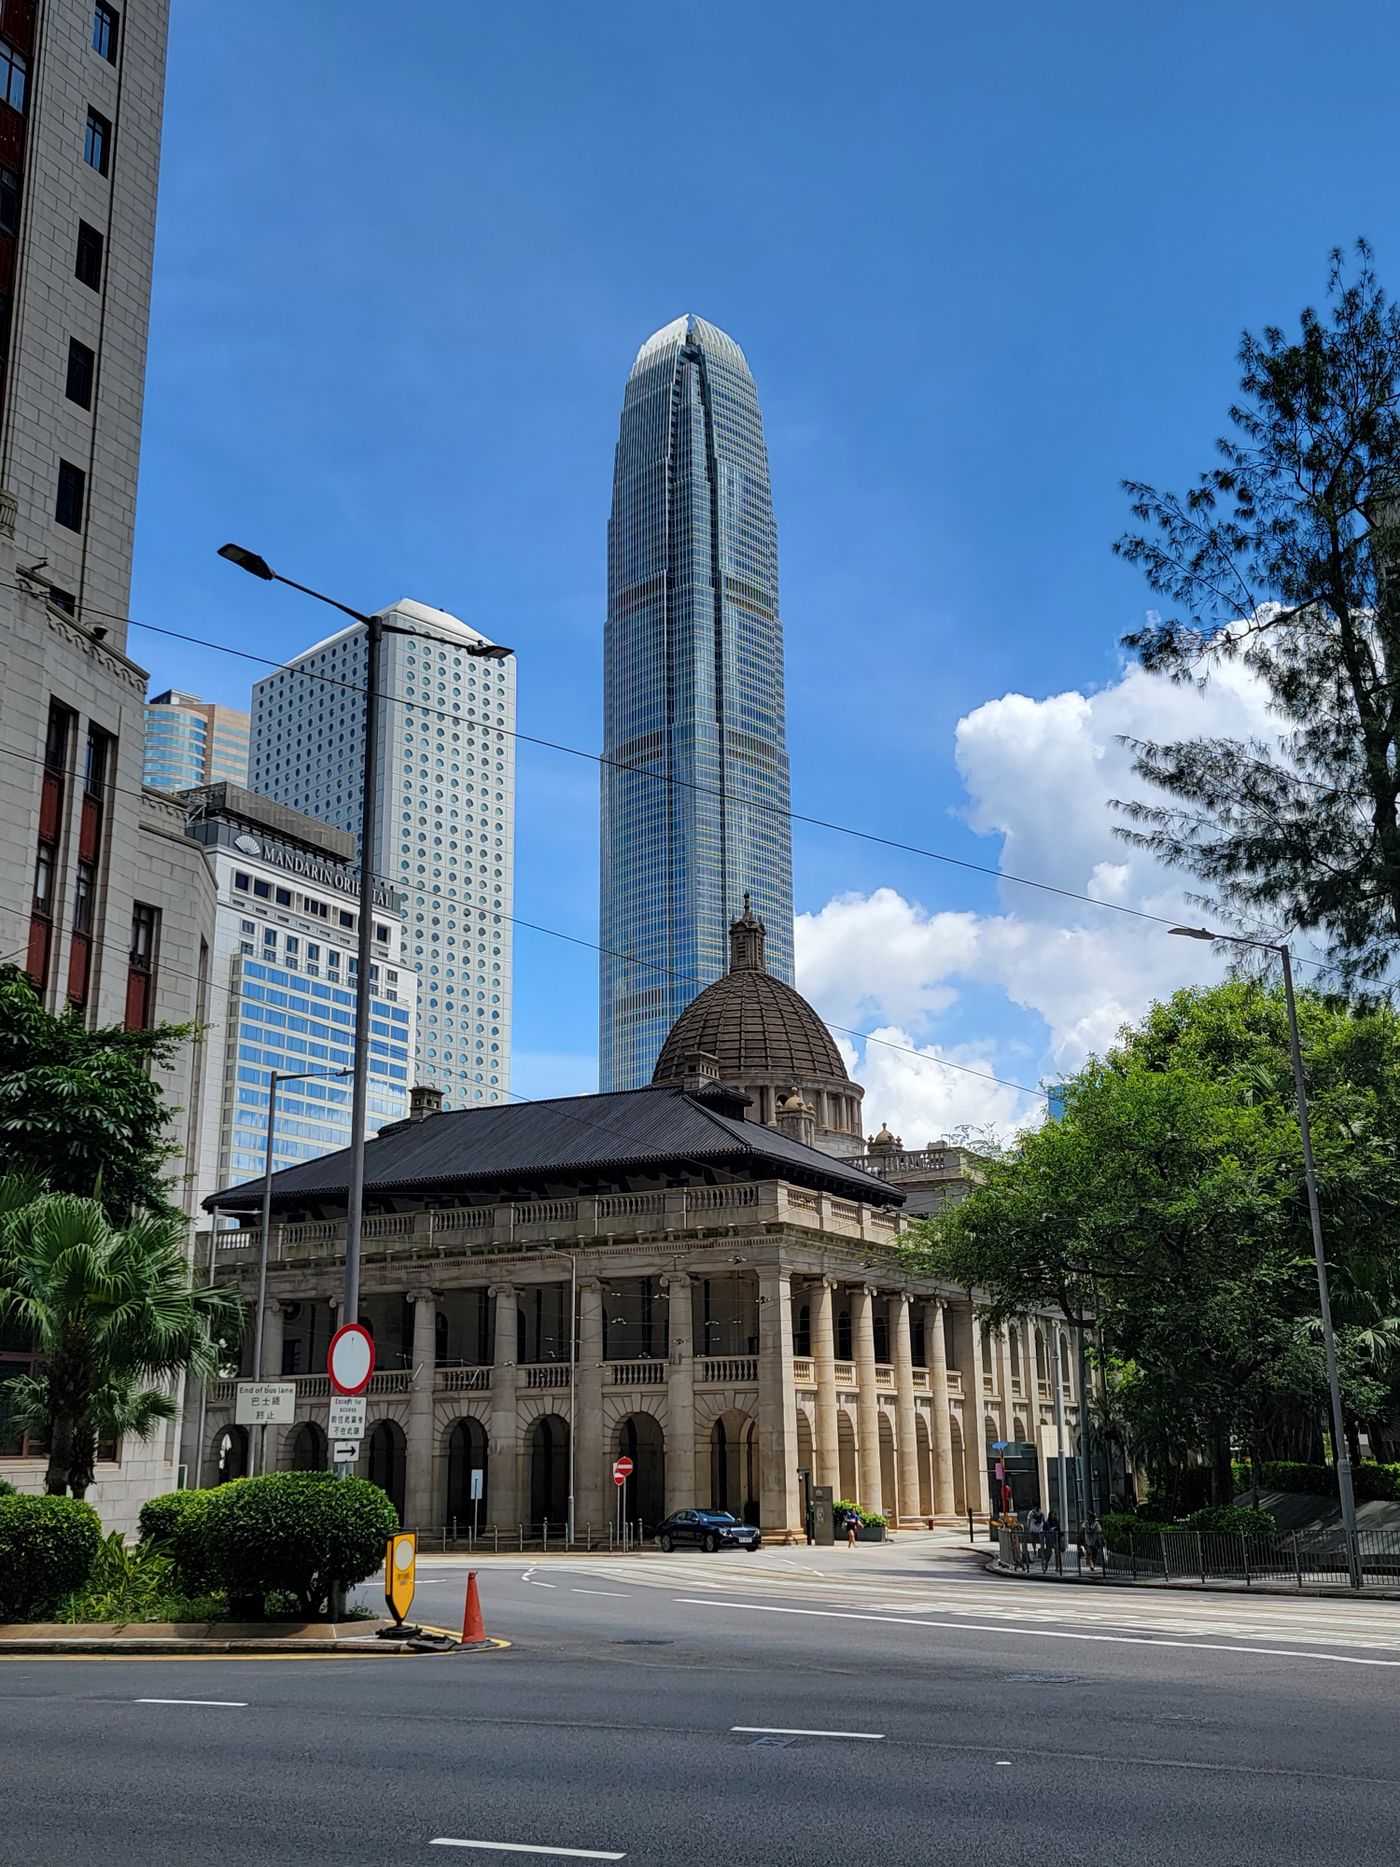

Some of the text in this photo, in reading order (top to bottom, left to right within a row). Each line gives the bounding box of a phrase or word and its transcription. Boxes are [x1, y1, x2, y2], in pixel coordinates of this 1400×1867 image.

[264, 844, 392, 908] MANDARIN ORIETAL
[239, 1386, 293, 1394] End of bus lane
